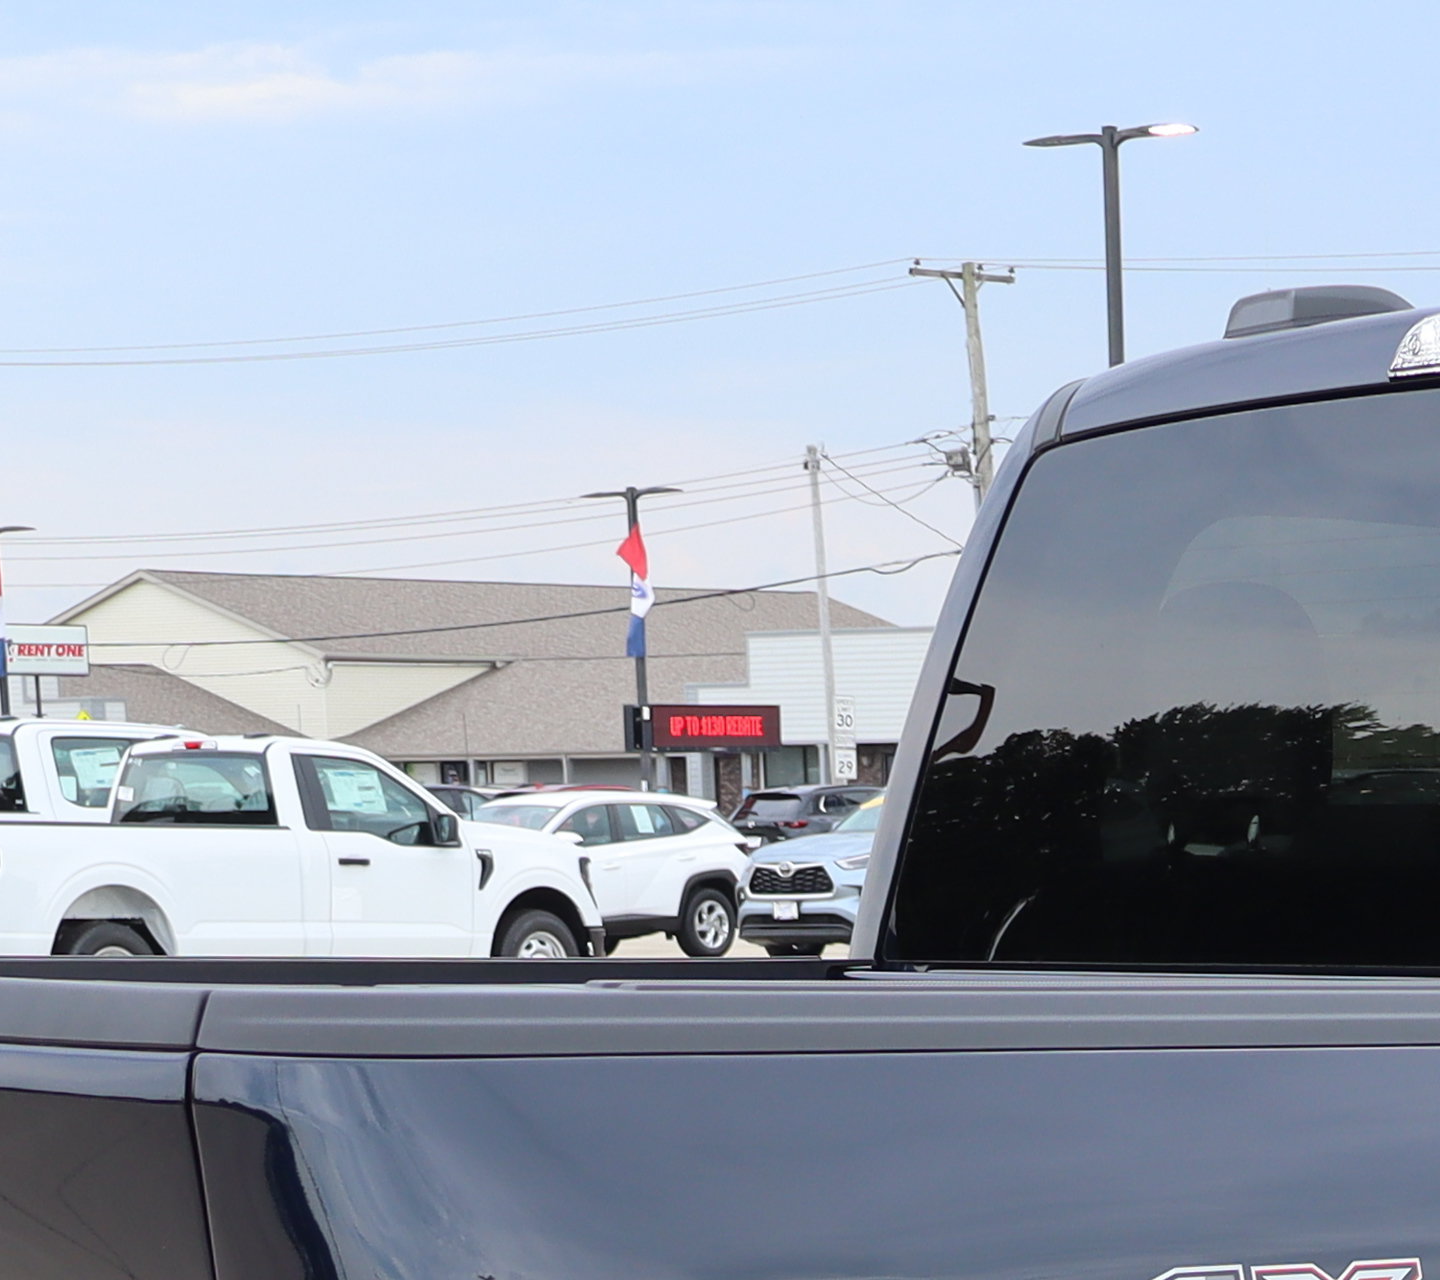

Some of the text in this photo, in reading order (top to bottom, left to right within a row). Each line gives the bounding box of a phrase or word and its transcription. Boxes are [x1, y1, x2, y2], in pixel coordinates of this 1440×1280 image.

[18, 644, 84, 657] RENT ONE
[670, 716, 684, 736] UP
[685, 716, 699, 736] TO
[726, 716, 764, 736] REBATE
[836, 713, 853, 728] 30
[838, 760, 854, 774] 29
